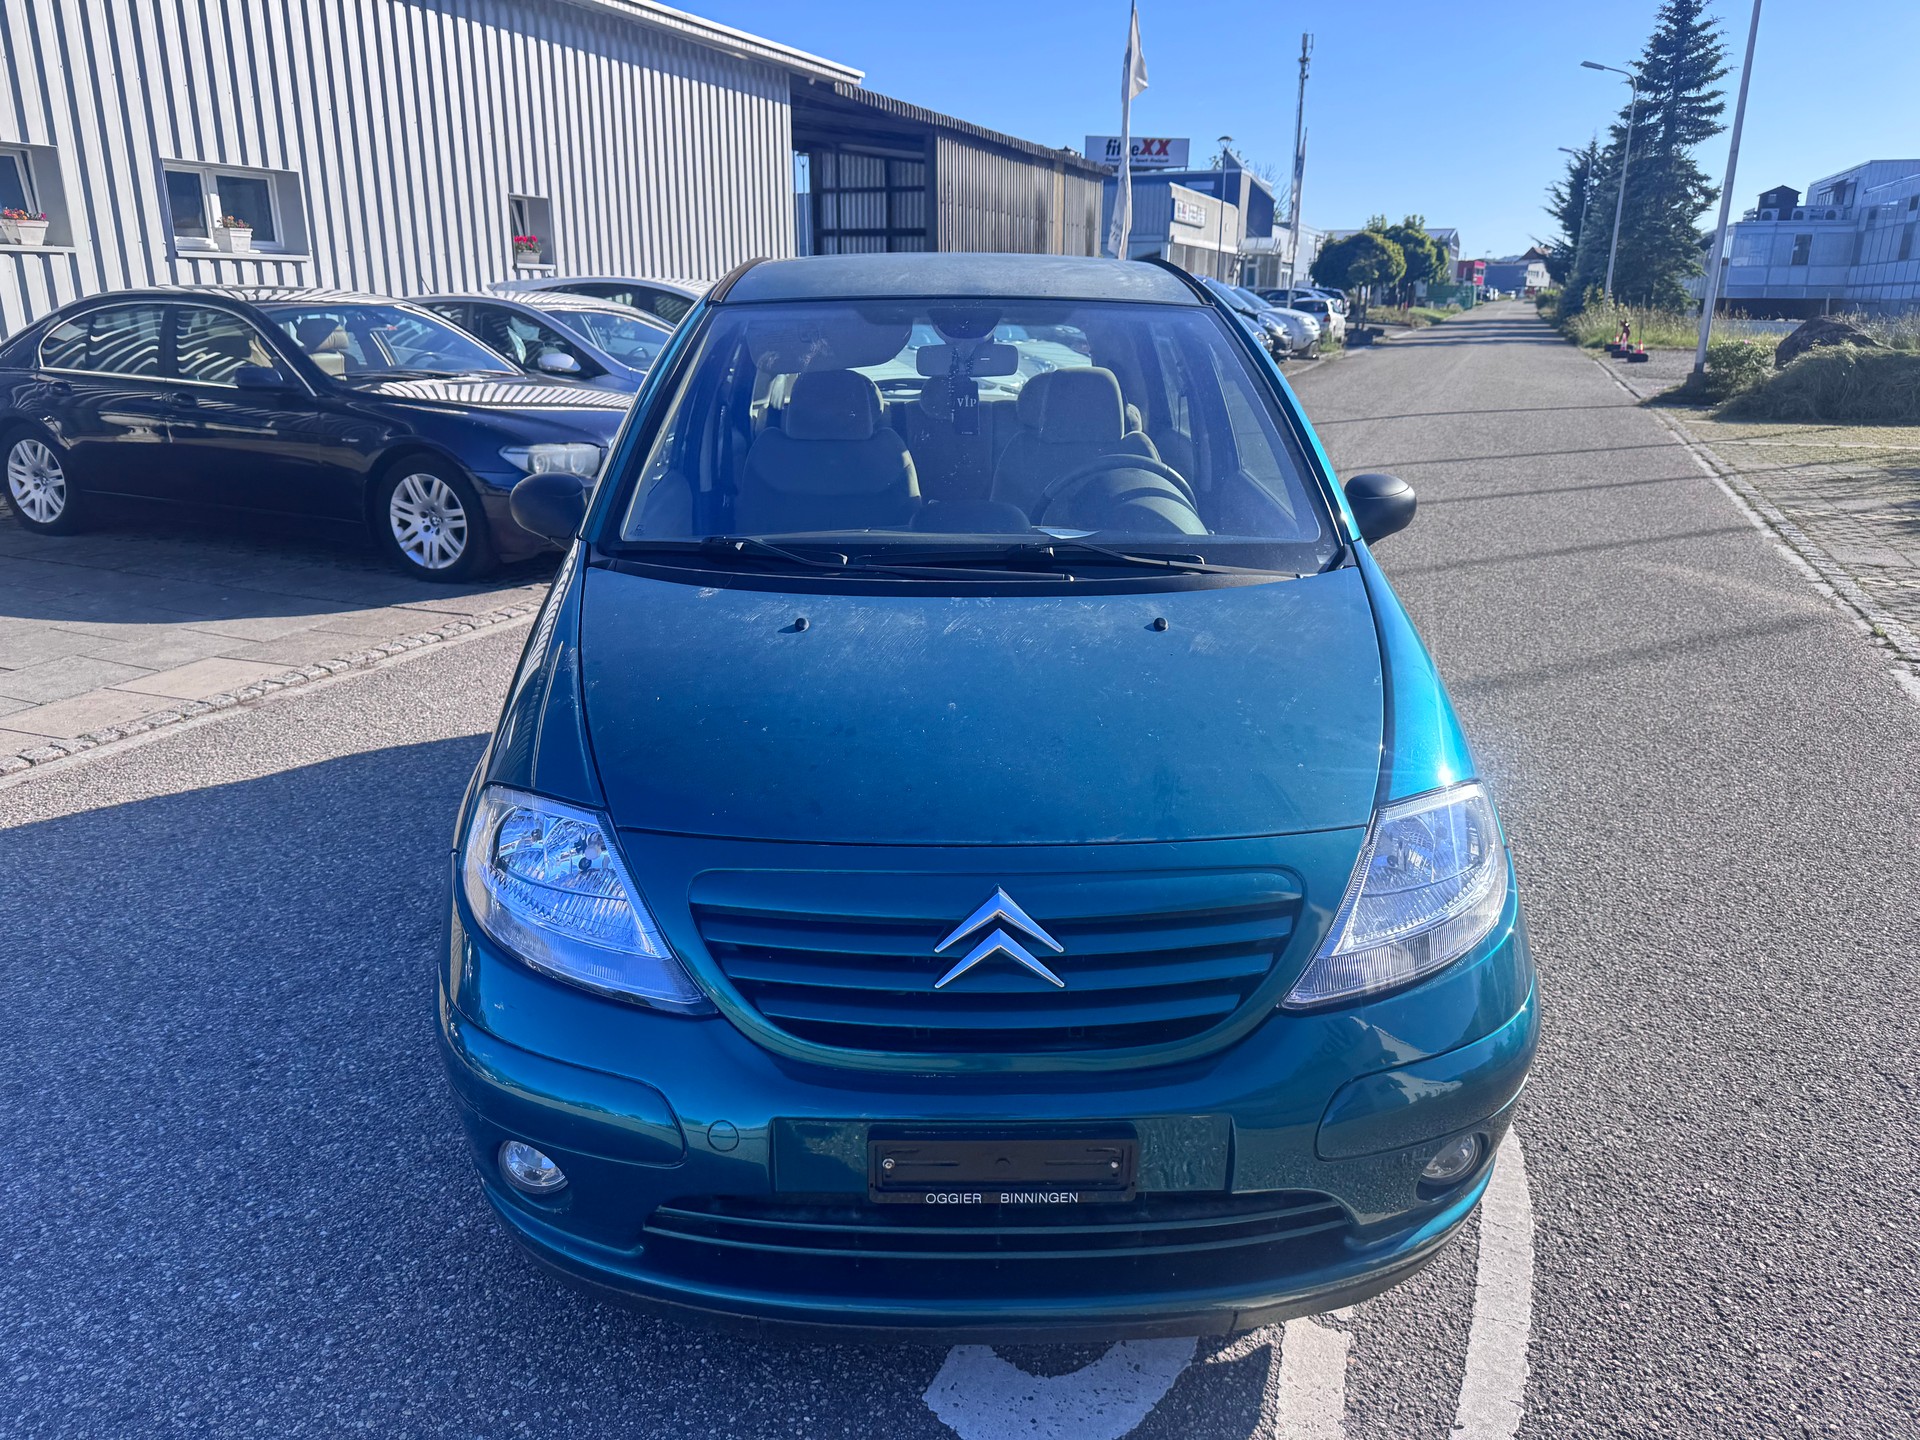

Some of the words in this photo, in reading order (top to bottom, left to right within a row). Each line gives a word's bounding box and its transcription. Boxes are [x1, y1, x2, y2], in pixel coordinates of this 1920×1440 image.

[1105, 138, 1172, 156] fiteXX
[925, 1193, 982, 1204] OGGIER
[1000, 1192, 1079, 1204] BINNINGEN
